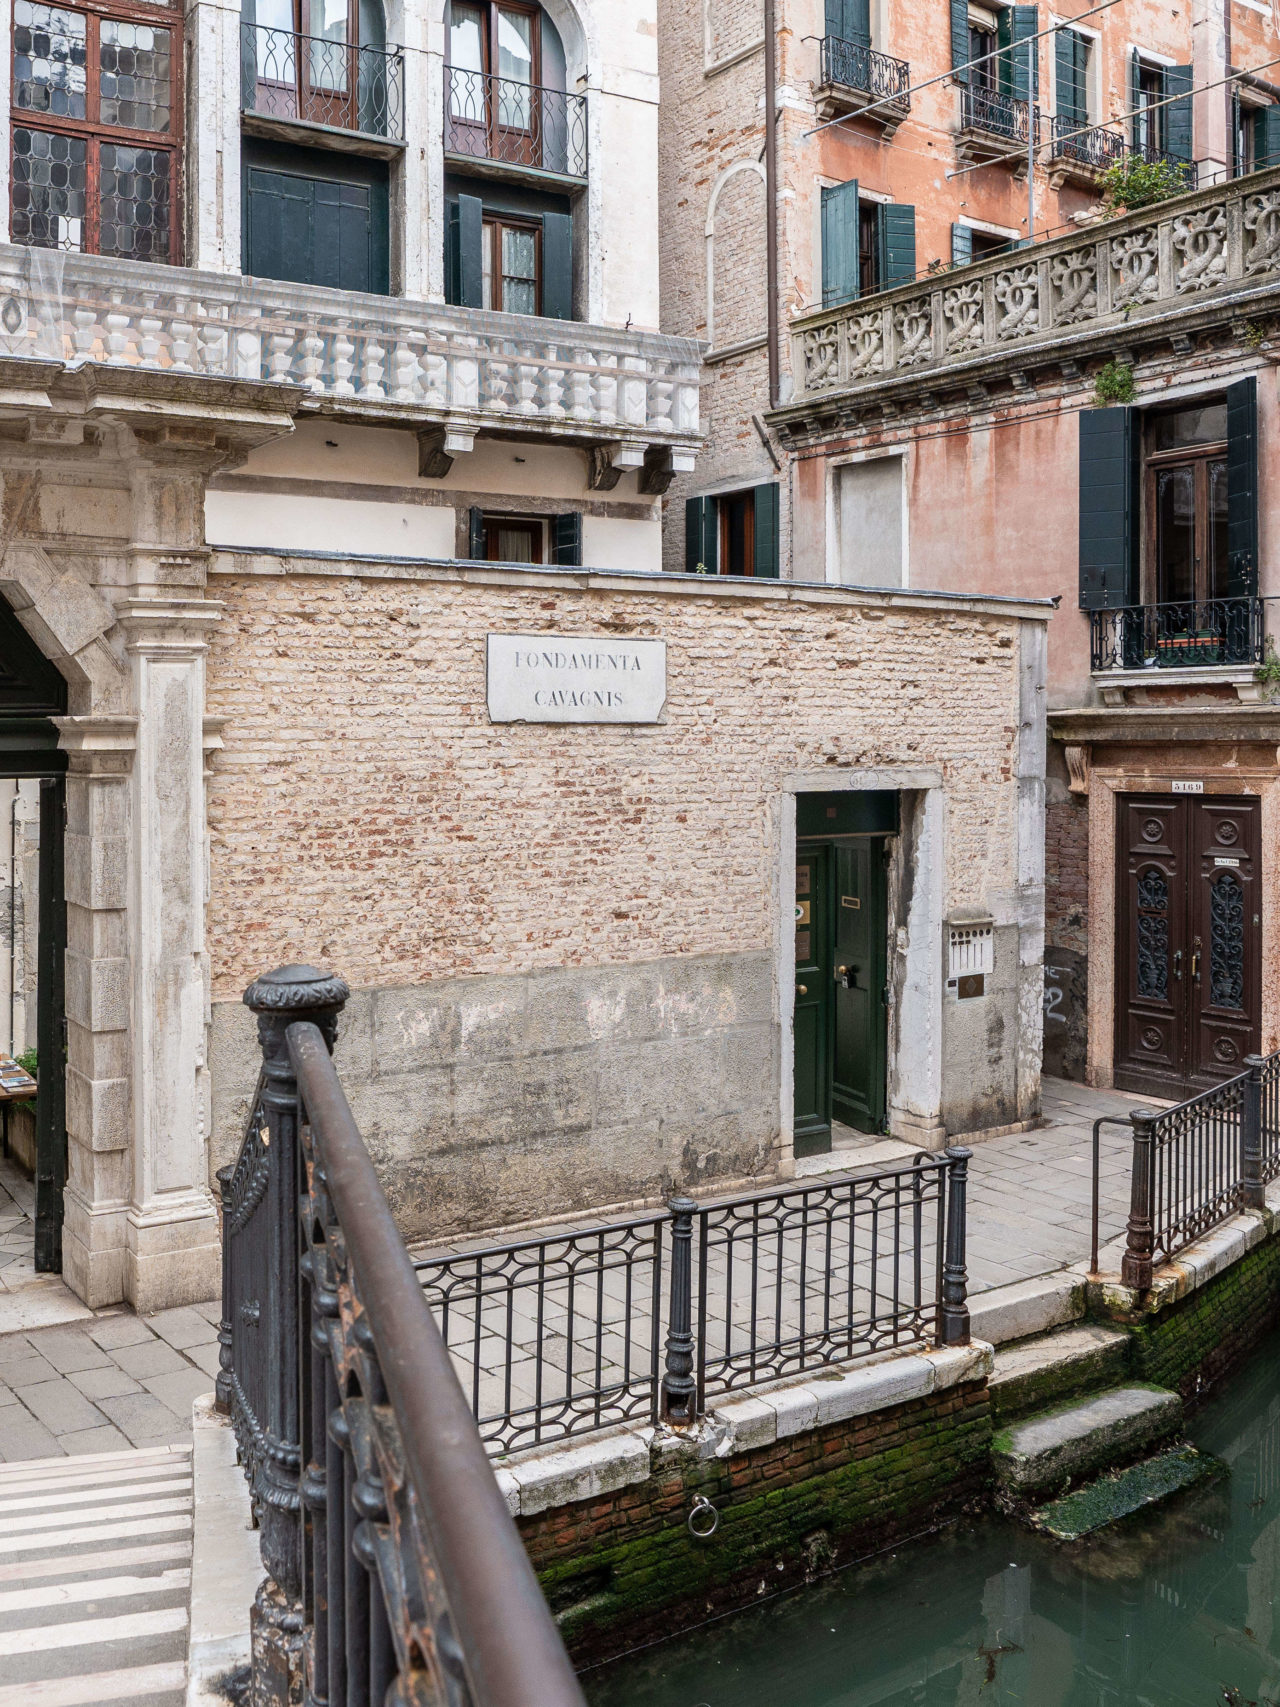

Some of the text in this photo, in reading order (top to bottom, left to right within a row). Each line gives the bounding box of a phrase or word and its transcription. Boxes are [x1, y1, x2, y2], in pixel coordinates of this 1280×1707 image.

[515, 651, 642, 671] FONDAMENTA
[534, 690, 623, 707] CAVAGNIS
[1174, 783, 1202, 791] 5169
